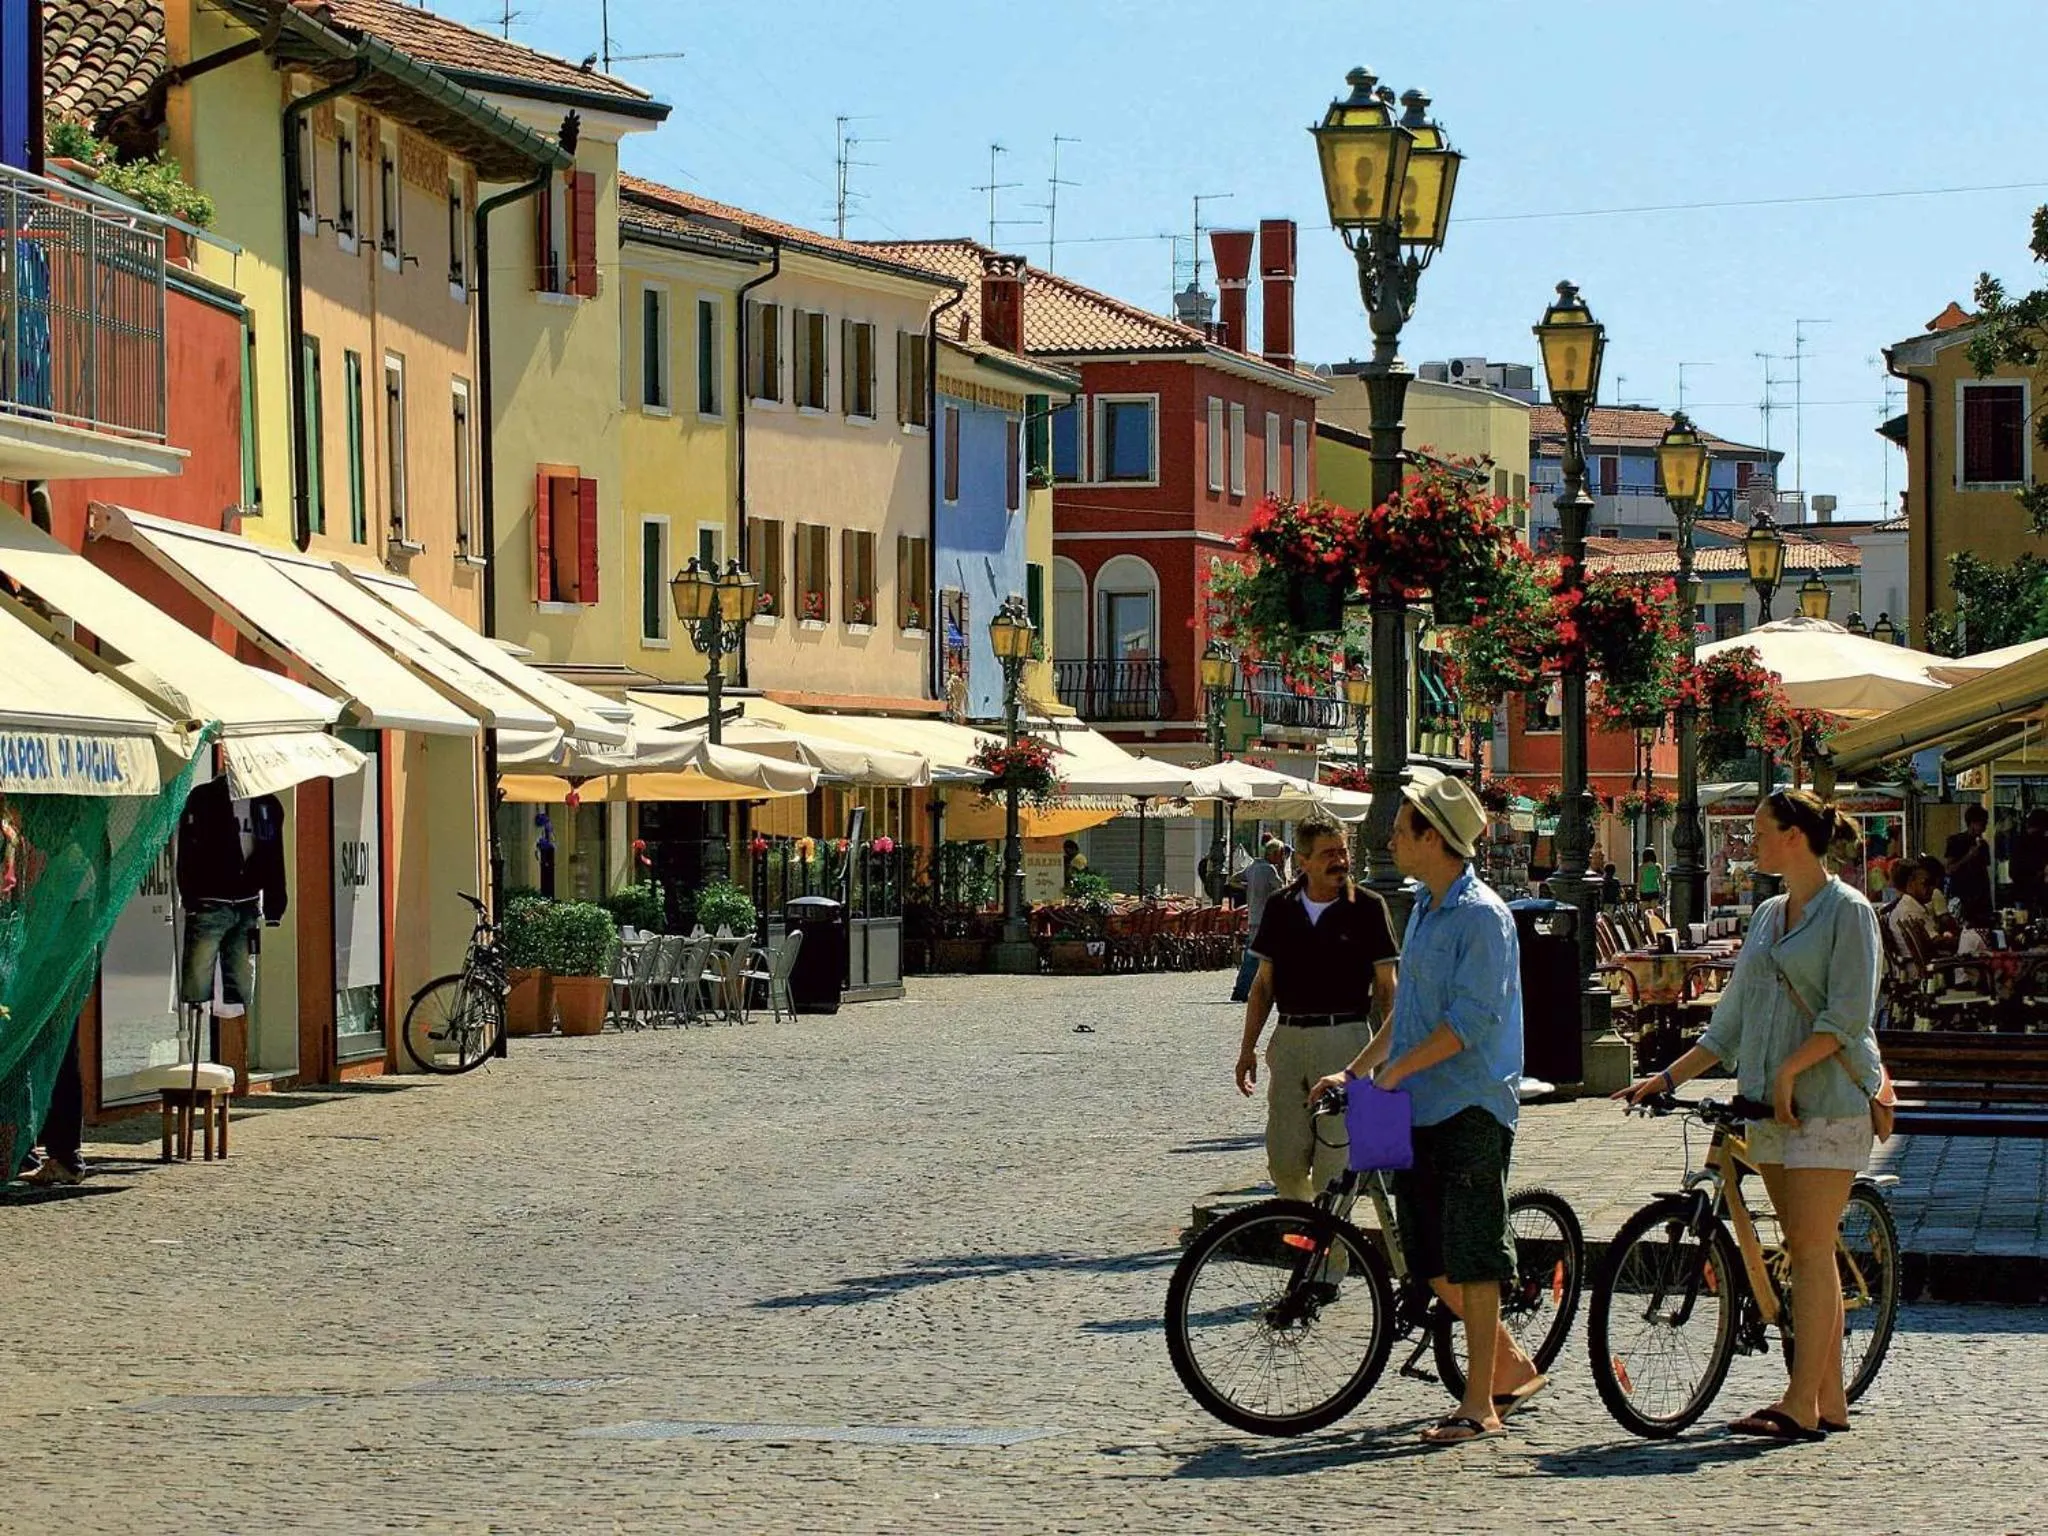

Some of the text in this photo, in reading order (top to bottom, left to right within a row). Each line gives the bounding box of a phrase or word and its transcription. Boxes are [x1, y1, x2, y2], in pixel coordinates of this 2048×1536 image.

[58, 738, 72, 780] DI
[76, 740, 124, 784] PUGLIA
[342, 841, 370, 887] SALDI
